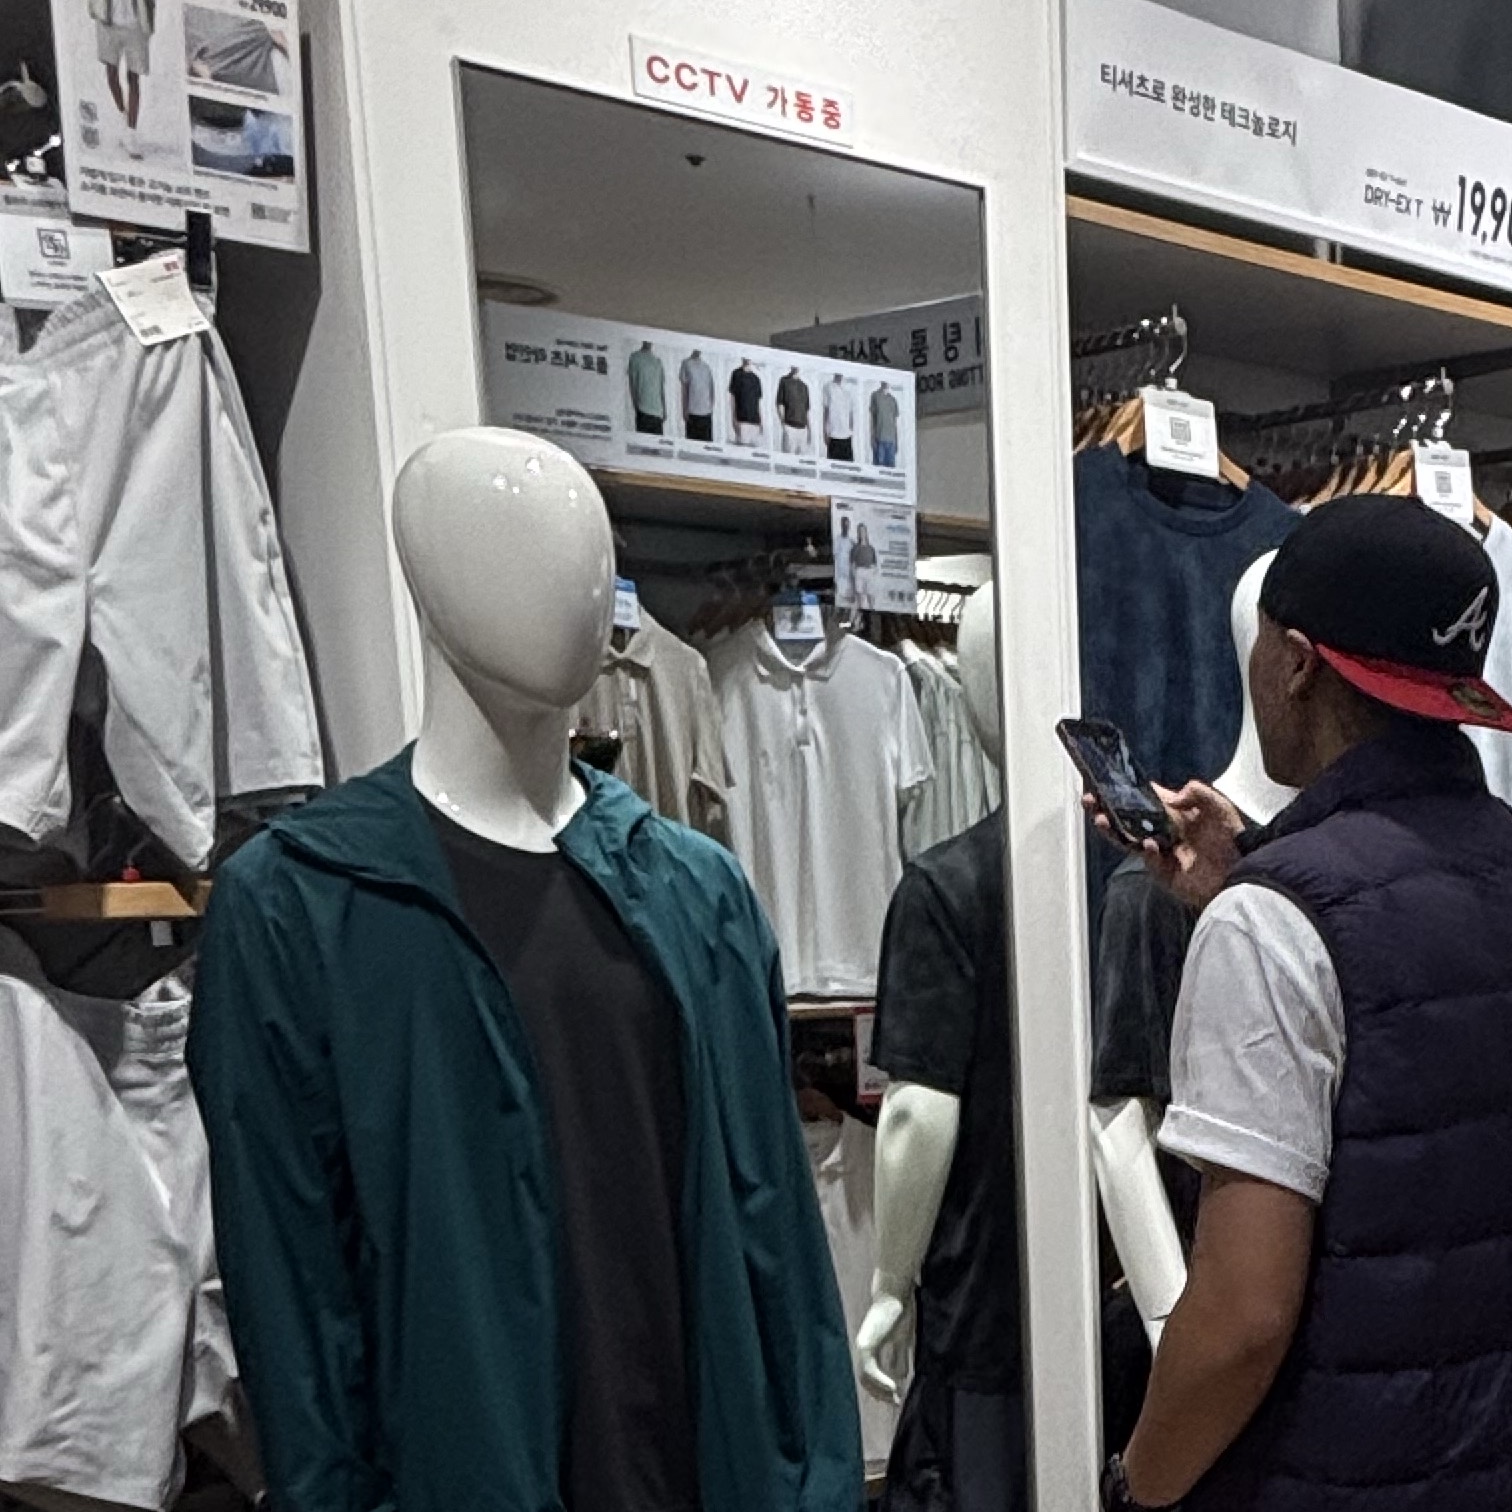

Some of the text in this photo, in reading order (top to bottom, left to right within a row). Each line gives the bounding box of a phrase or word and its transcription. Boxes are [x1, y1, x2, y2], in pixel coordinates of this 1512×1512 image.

[646, 54, 842, 130] CCTV 가동중
[1100, 62, 1297, 147] 티셔츠로 완성한 테크놀로지
[1363, 183, 1411, 216] DRY-EX
[1415, 198, 1423, 218] T
[1431, 585, 1489, 652] A
